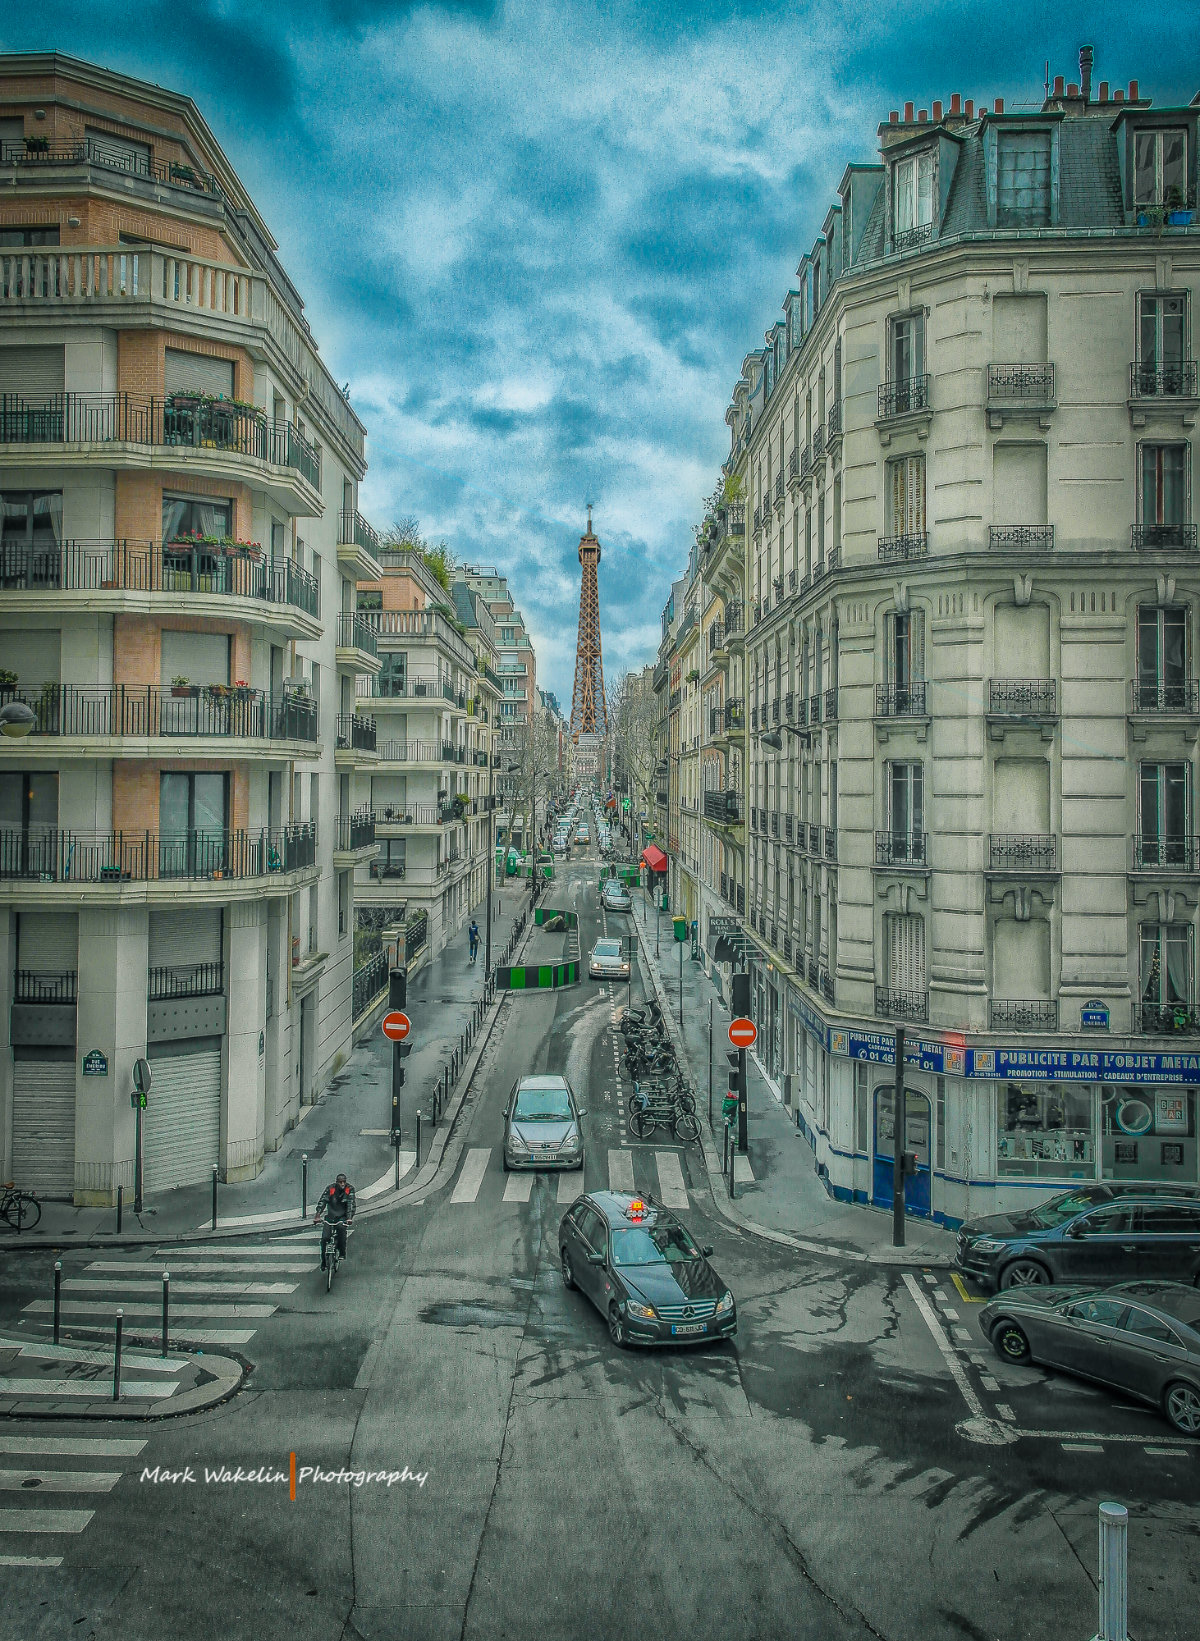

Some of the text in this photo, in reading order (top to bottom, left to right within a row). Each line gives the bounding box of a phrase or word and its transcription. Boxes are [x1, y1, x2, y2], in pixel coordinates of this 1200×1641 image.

[850, 1032, 880, 1045] PUBLICITE
[881, 1036, 894, 1047] PAR
[921, 1043, 943, 1055] METAL
[869, 1052, 879, 1061] 01
[882, 1053, 894, 1063] 45
[923, 1060, 934, 1070] 01
[1000, 1052, 1067, 1066] PUBLICITE
[1072, 1053, 1099, 1066] PAR
[1104, 1055, 1156, 1068] L'OBJET
[1007, 1069, 1048, 1077] PROMOTION
[1054, 1070, 1097, 1079] STIMULATION
[1103, 1072, 1135, 1080] CADEAUX
[1161, 1100, 1182, 1110] BEL
